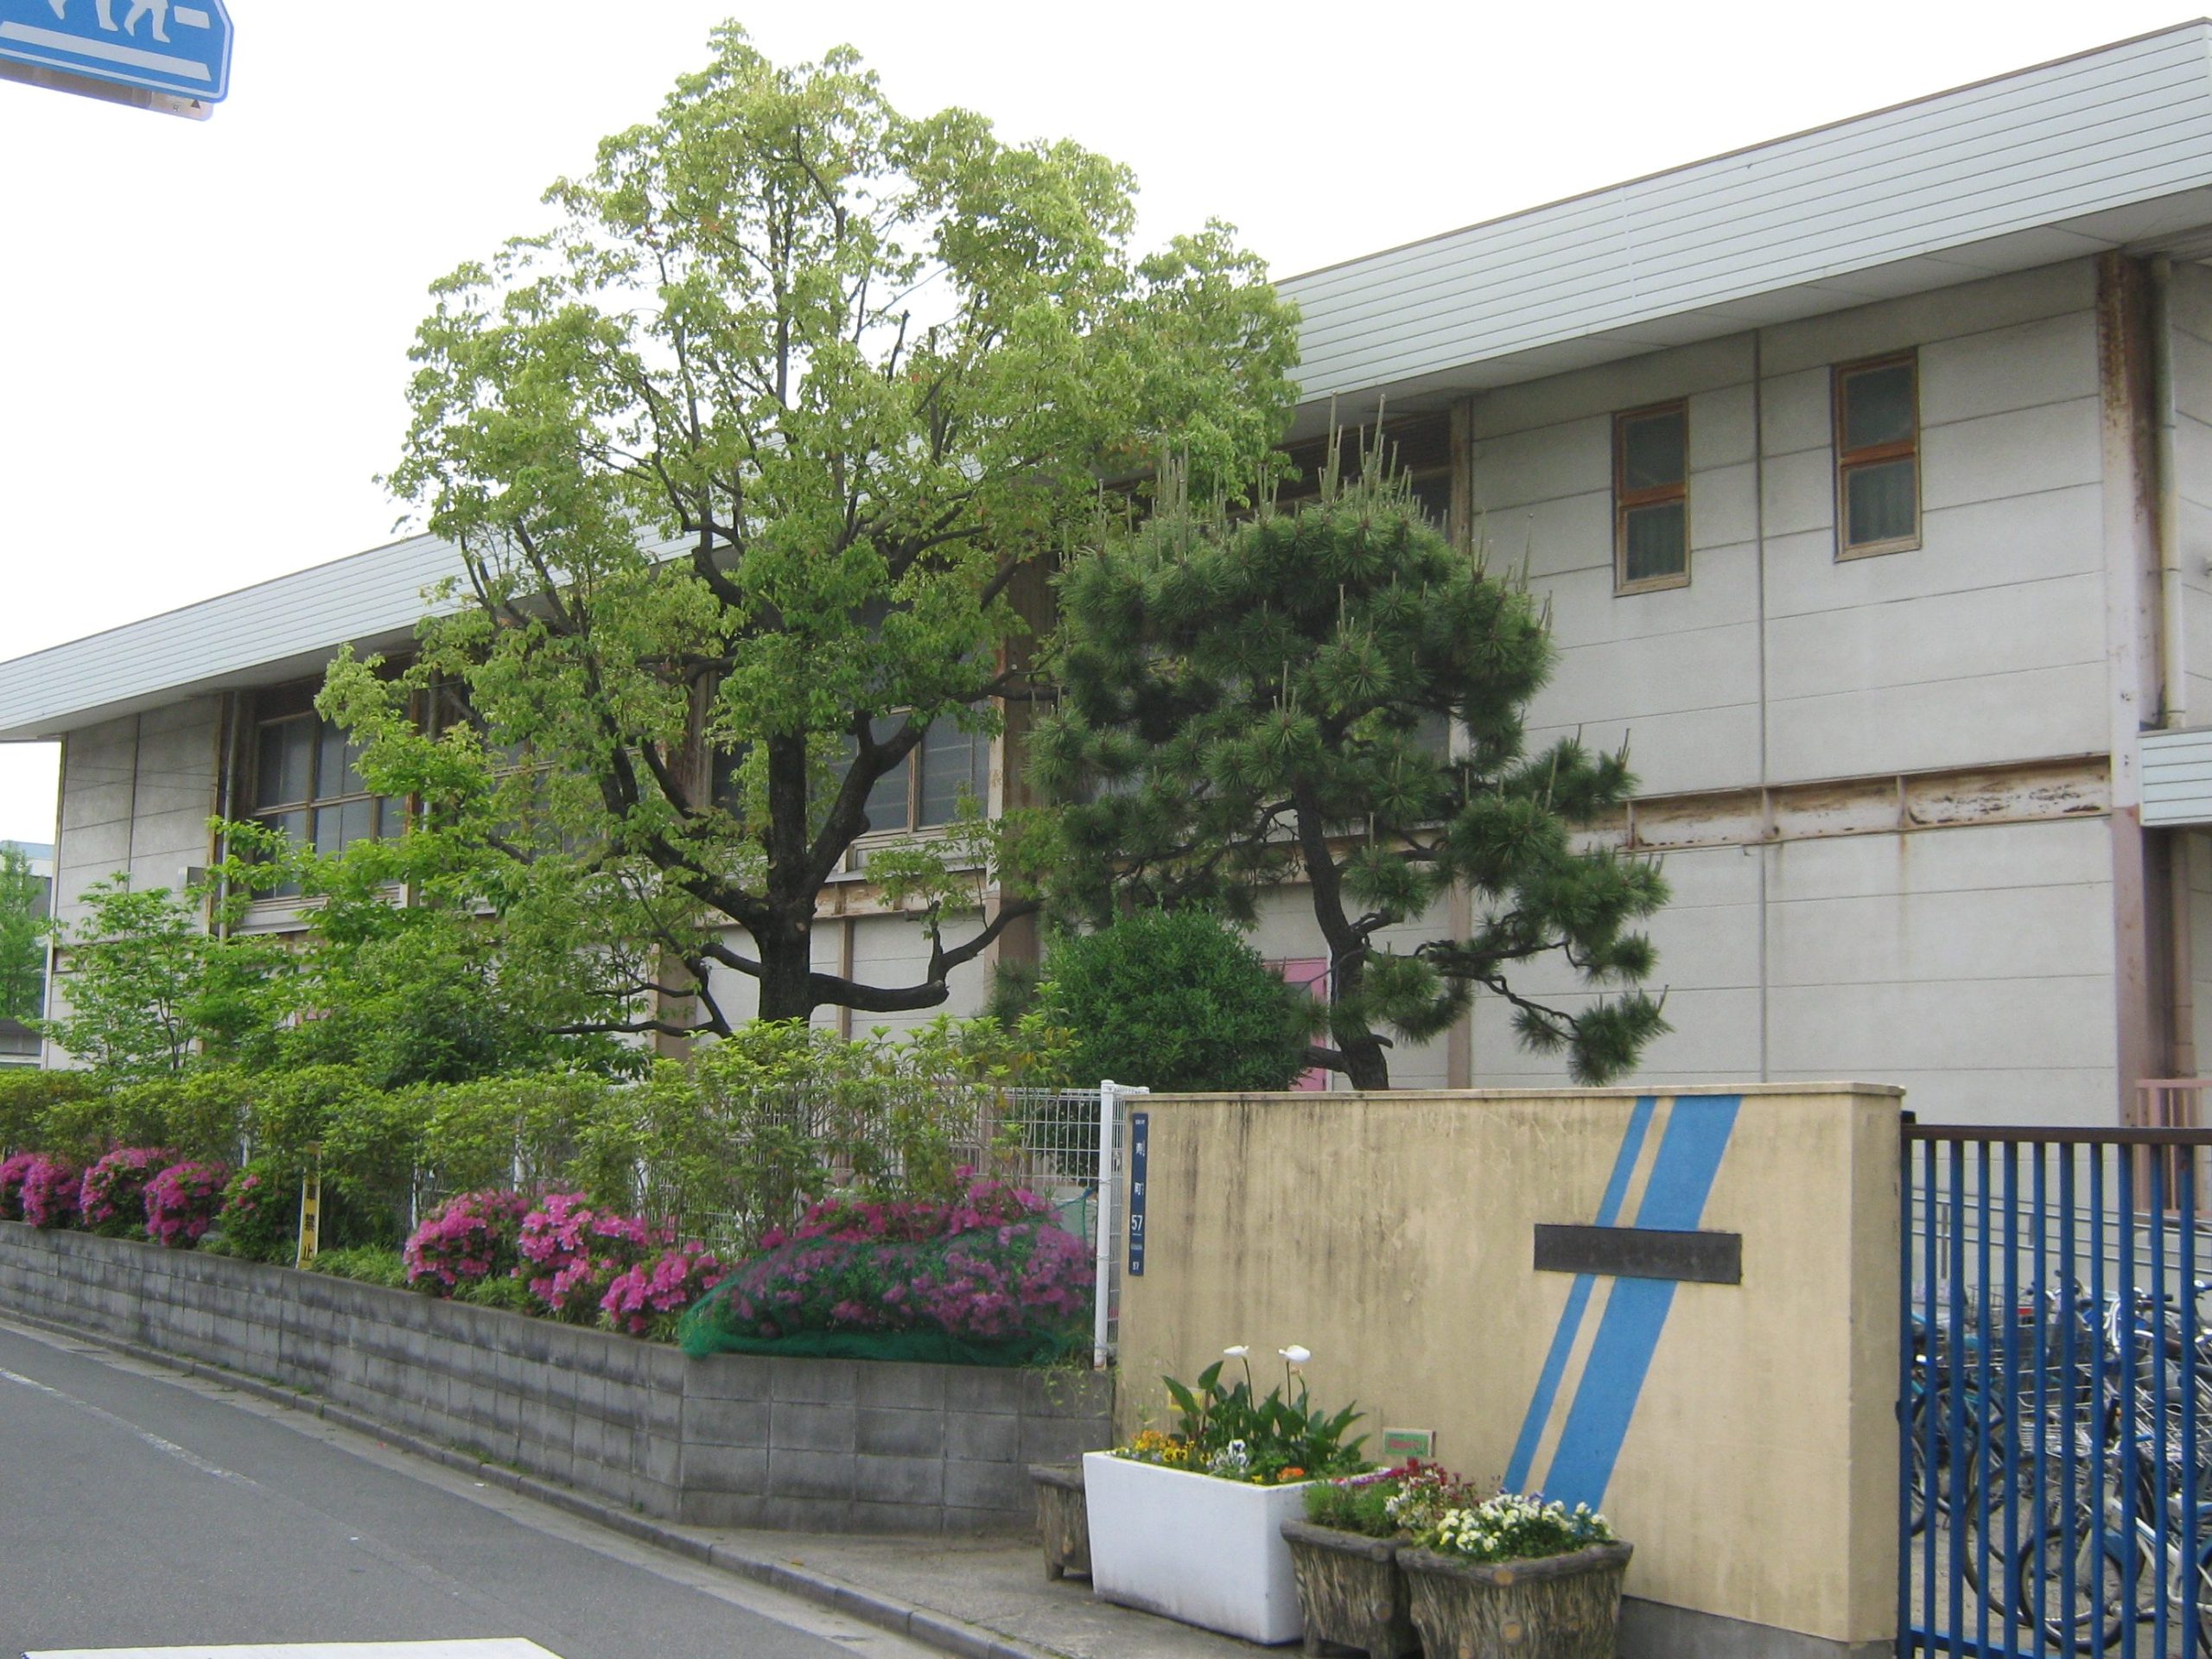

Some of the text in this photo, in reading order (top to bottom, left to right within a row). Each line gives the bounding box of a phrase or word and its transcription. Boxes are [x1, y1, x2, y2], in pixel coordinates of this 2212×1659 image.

[302, 1168, 317, 1262] 車禁止
[1131, 1214, 1143, 1231] 57
